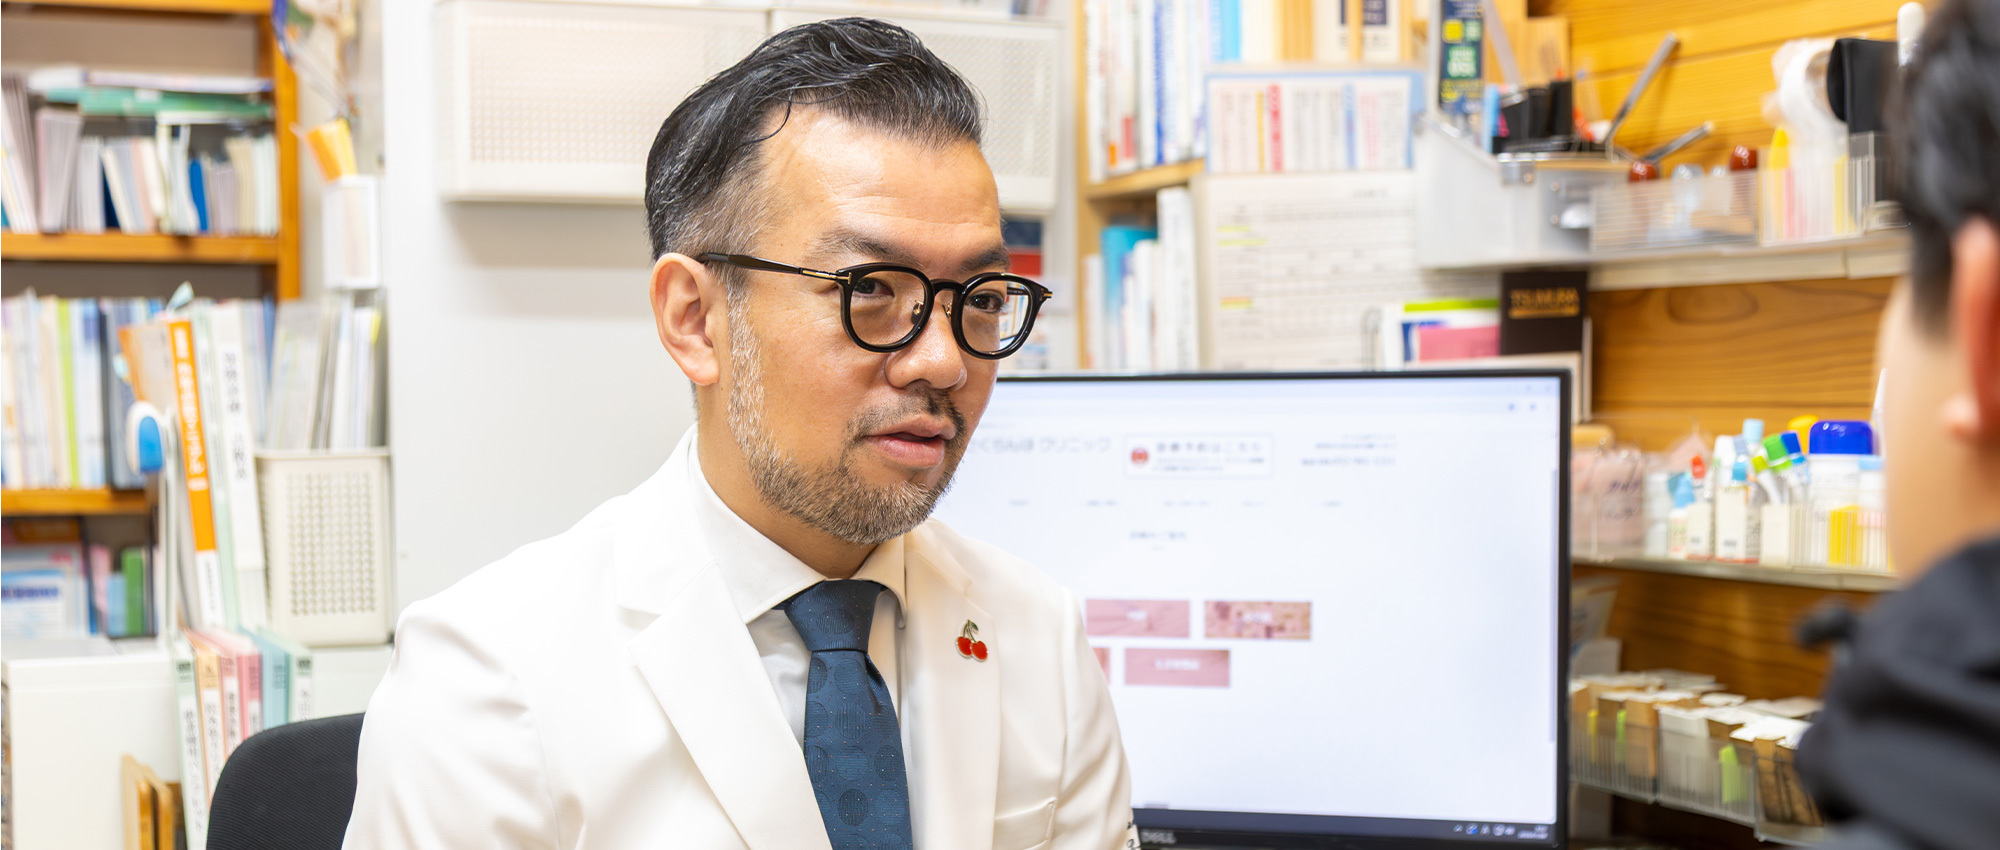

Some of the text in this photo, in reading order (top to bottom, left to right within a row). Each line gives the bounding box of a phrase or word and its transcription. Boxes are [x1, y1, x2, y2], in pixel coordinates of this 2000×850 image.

[1509, 287, 1580, 309] TSUMURA
[1039, 436, 1112, 454] クリニック
